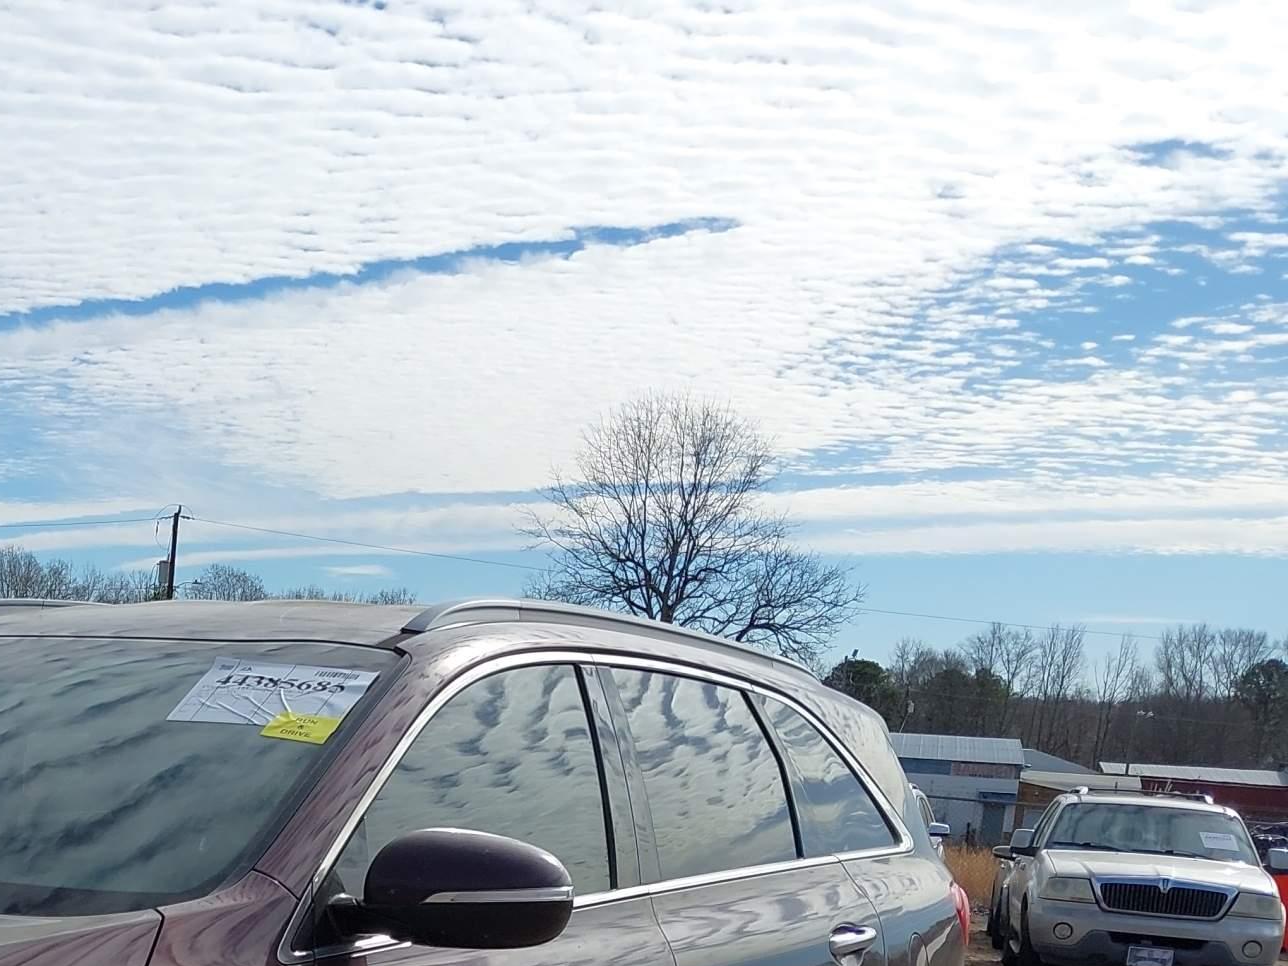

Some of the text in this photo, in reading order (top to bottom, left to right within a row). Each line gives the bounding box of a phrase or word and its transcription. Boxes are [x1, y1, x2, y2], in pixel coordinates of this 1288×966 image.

[215, 675, 345, 694] 44385685
[295, 717, 318, 725] RUN
[279, 728, 311, 738] DRIVE
